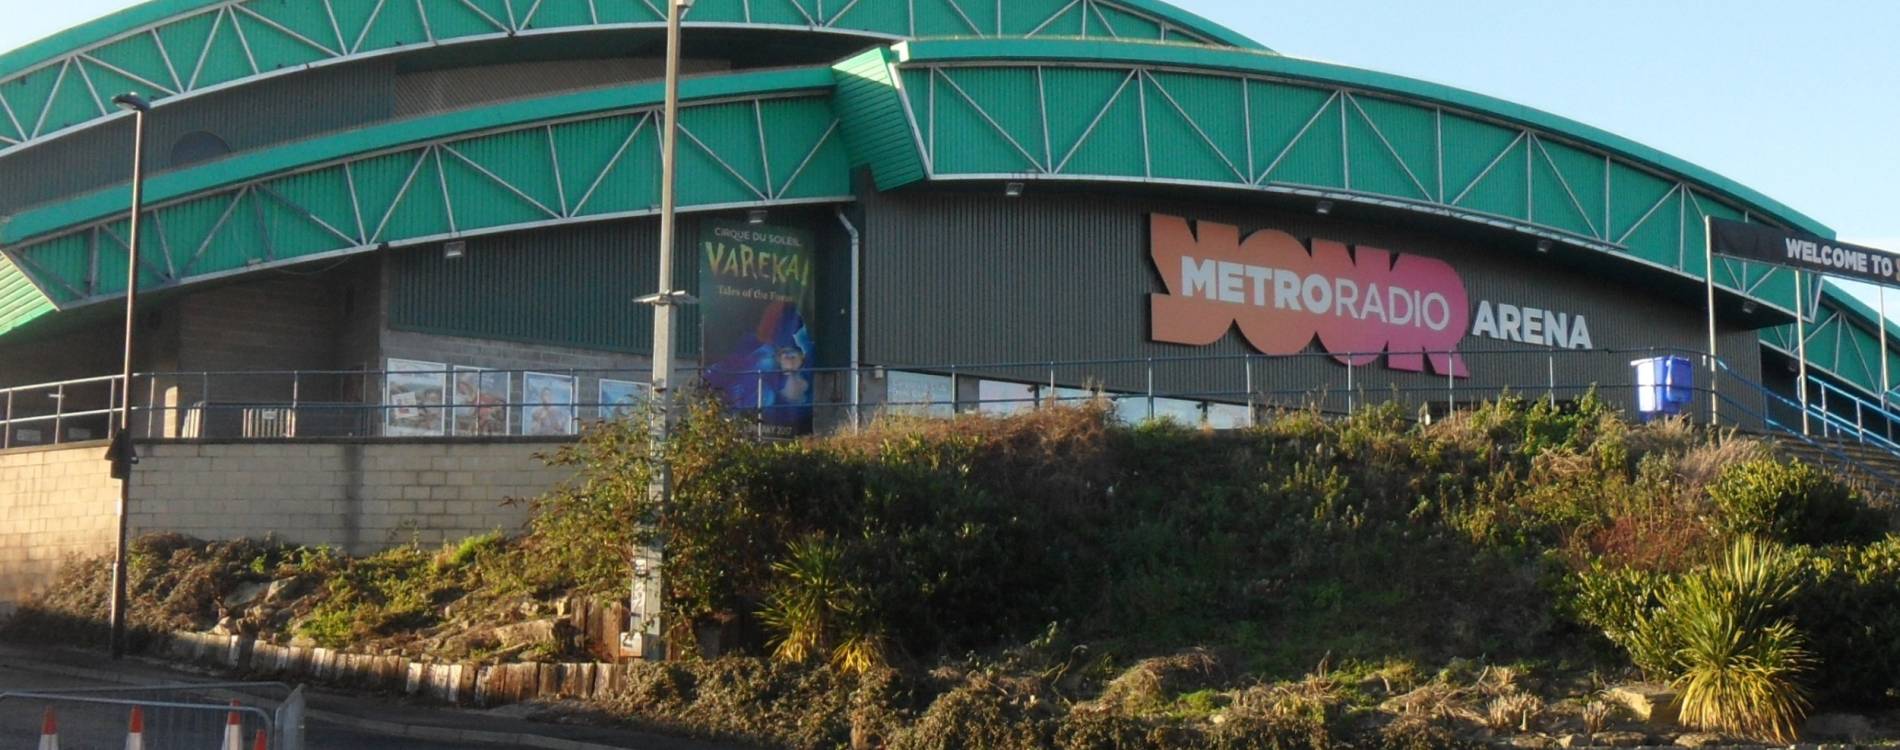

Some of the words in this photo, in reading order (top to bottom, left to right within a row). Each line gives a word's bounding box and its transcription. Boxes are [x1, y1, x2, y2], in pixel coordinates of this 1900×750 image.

[714, 227, 751, 242] CIRQUE
[752, 232, 767, 242] DU
[769, 236, 801, 247] SOLEIL
[705, 241, 809, 286] VAREKAI
[1785, 238, 1868, 273] WELCOME
[1872, 255, 1893, 277] TO
[742, 287, 752, 298] of
[753, 288, 768, 300] the
[1472, 300, 1593, 349] ARENA
